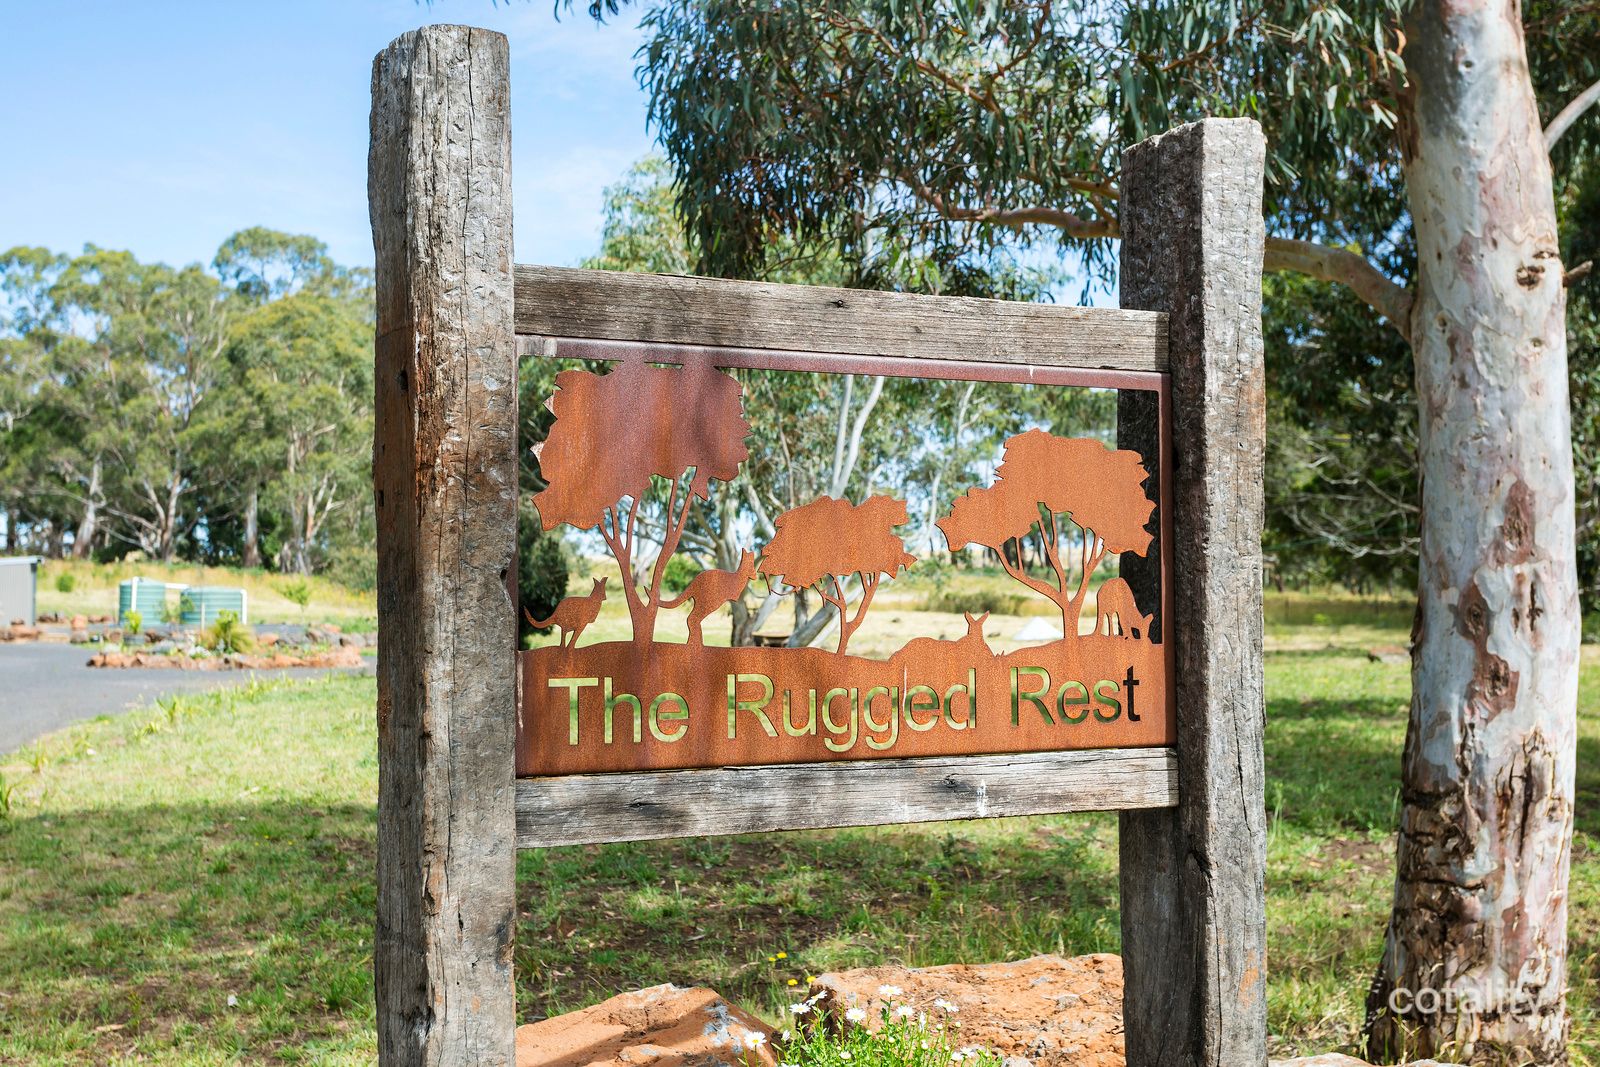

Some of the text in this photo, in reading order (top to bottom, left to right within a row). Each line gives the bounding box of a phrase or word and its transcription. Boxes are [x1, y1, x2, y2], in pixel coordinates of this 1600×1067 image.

[548, 665, 1141, 753] The Rugged Rest
